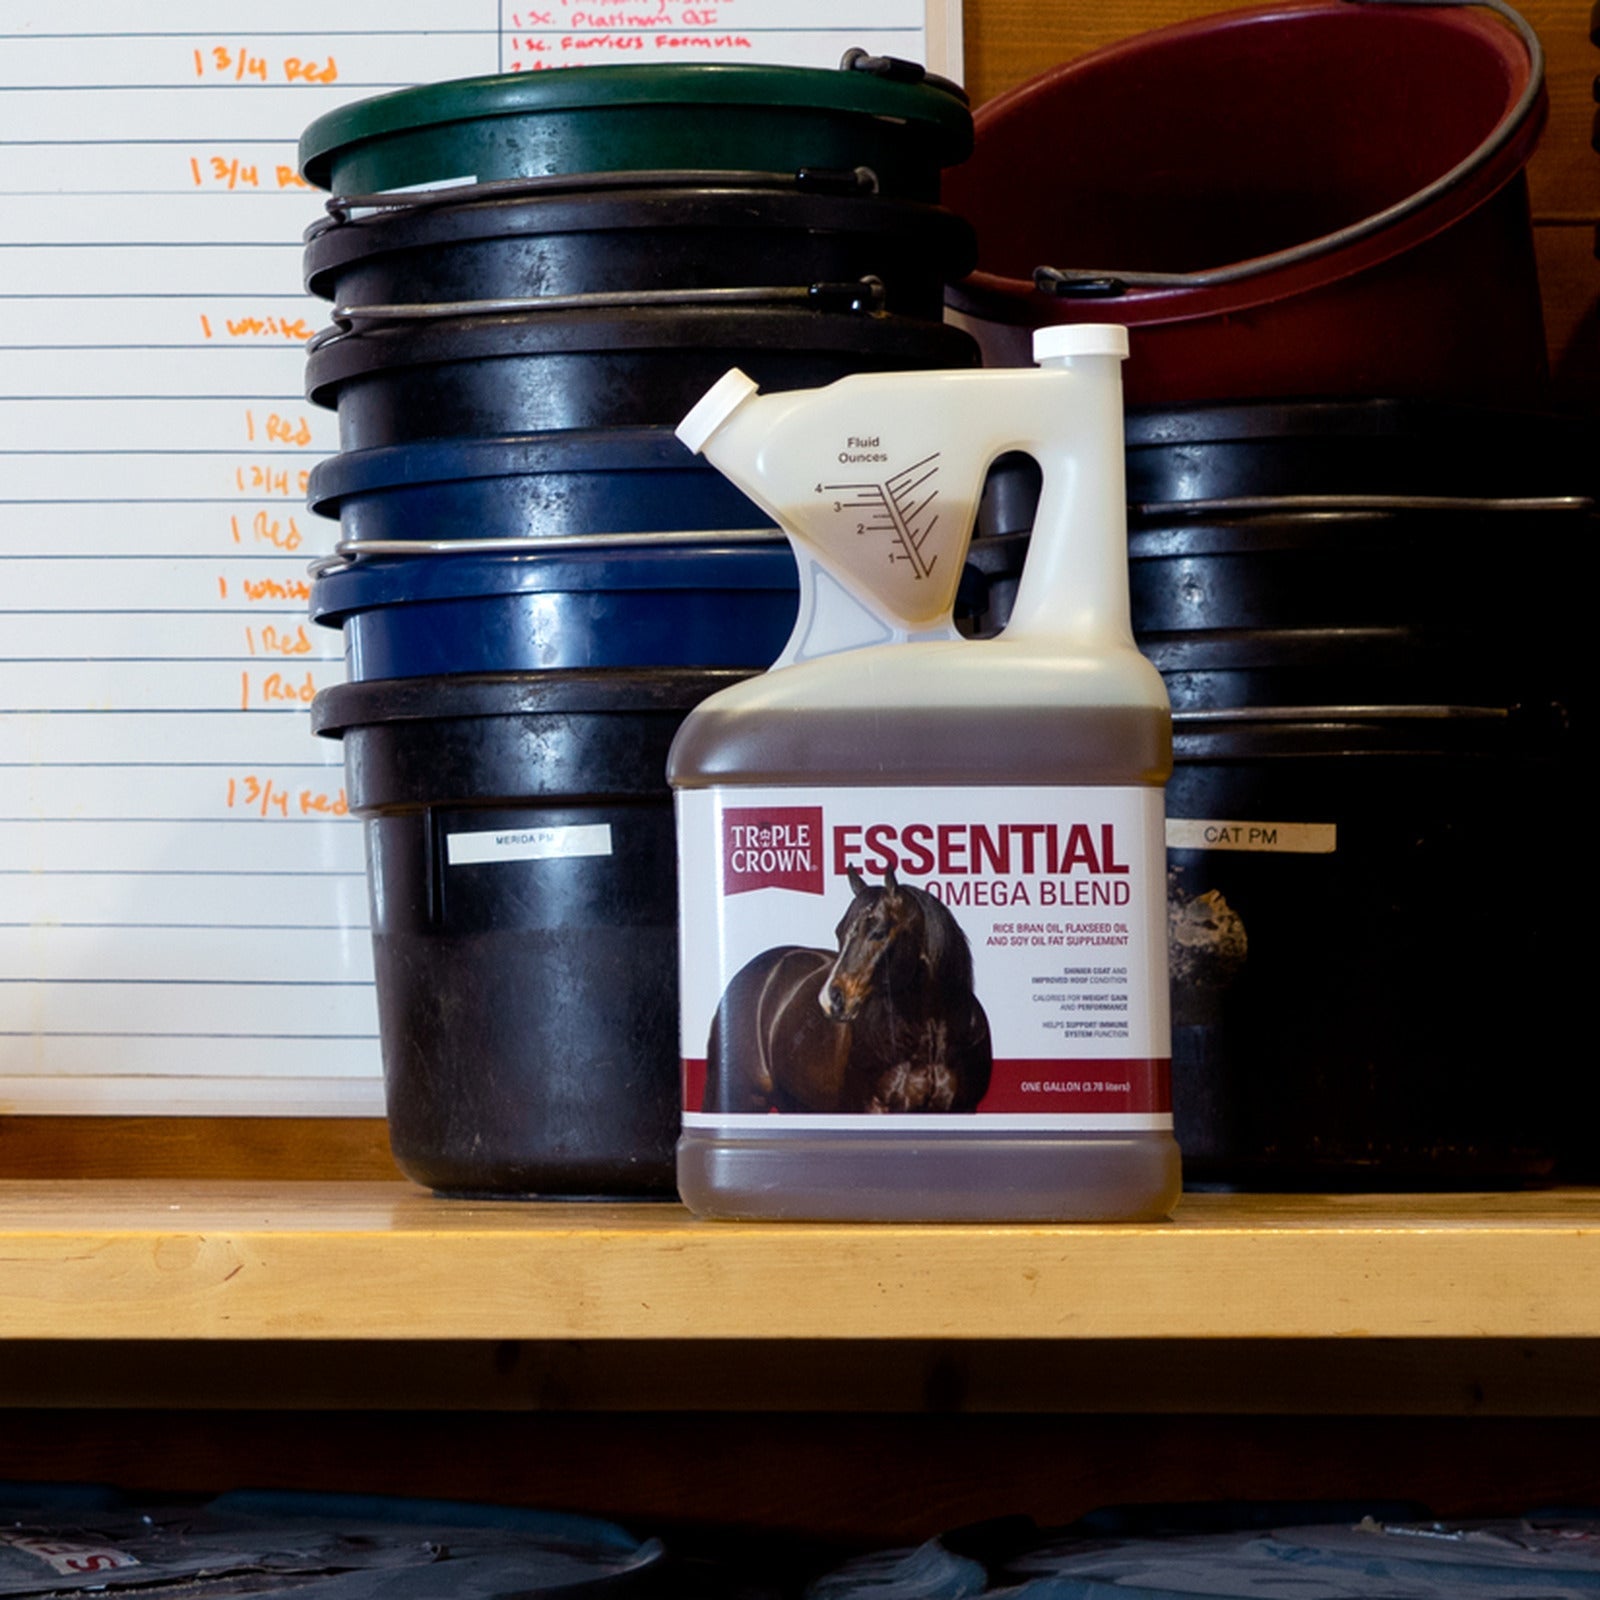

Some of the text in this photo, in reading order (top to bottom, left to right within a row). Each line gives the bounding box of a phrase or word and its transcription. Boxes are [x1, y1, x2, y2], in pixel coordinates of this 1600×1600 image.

[284, 56, 338, 84] Red
[266, 413, 312, 446] Red
[847, 436, 880, 448] Fluid
[838, 452, 888, 463] Ounces
[814, 483, 823, 493] 4
[834, 502, 842, 512] 3
[253, 510, 303, 550] Red
[857, 523, 865, 535] 2
[261, 625, 312, 655] Red
[495, 834, 536, 846] MERIDA
[1203, 826, 1278, 845] CAT PM
[833, 824, 1130, 875] ESSENTIAL
[1039, 880, 1131, 906] BLEND
[992, 922, 1128, 935] RICE BRAN OIL, FLAXSEED OIL
[986, 936, 1129, 947] AND SOY OIL FAT SUPPLEMENT
[1112, 967, 1127, 975] AND
[1031, 976, 1127, 984] IMPROVED HOOF CONDITION
[1032, 994, 1128, 1002] CALORIES FOR WEIGHT GAIN
[1060, 1003, 1128, 1011] AND PERFORMANCE
[1042, 1021, 1128, 1029] HELPS SUPPORT IMMUNE
[1064, 1030, 1129, 1038] SYSTEM FUNCTION
[1021, 1081, 1131, 1093] ONE GALLON (3.78 liters)
